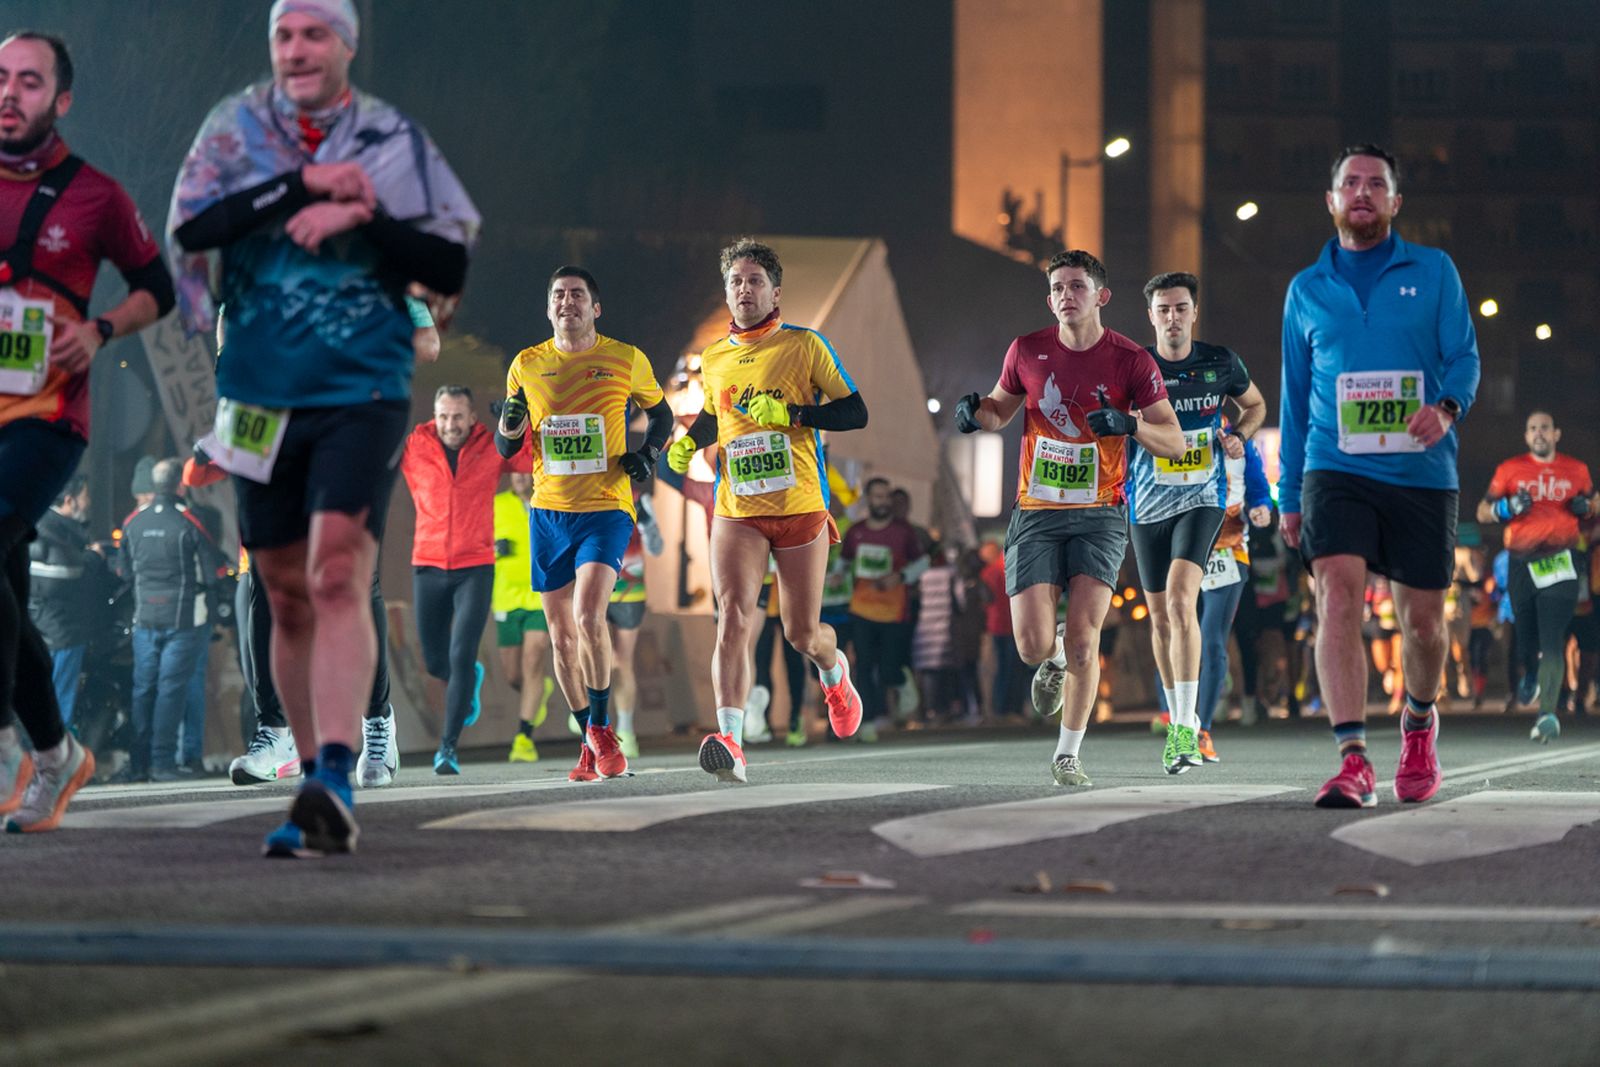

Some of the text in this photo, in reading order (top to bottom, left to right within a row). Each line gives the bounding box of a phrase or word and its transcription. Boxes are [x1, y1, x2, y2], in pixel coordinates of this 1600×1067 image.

[1356, 381, 1393, 390] NOCHE DE
[1175, 393, 1220, 412] ANTÓN
[1346, 391, 1363, 401] SAN
[1050, 409, 1067, 427] 43
[1356, 401, 1407, 425] 7287
[236, 409, 267, 443] 60
[553, 436, 592, 455] 5212
[734, 451, 786, 476] 13993
[1042, 460, 1089, 483] 13192
